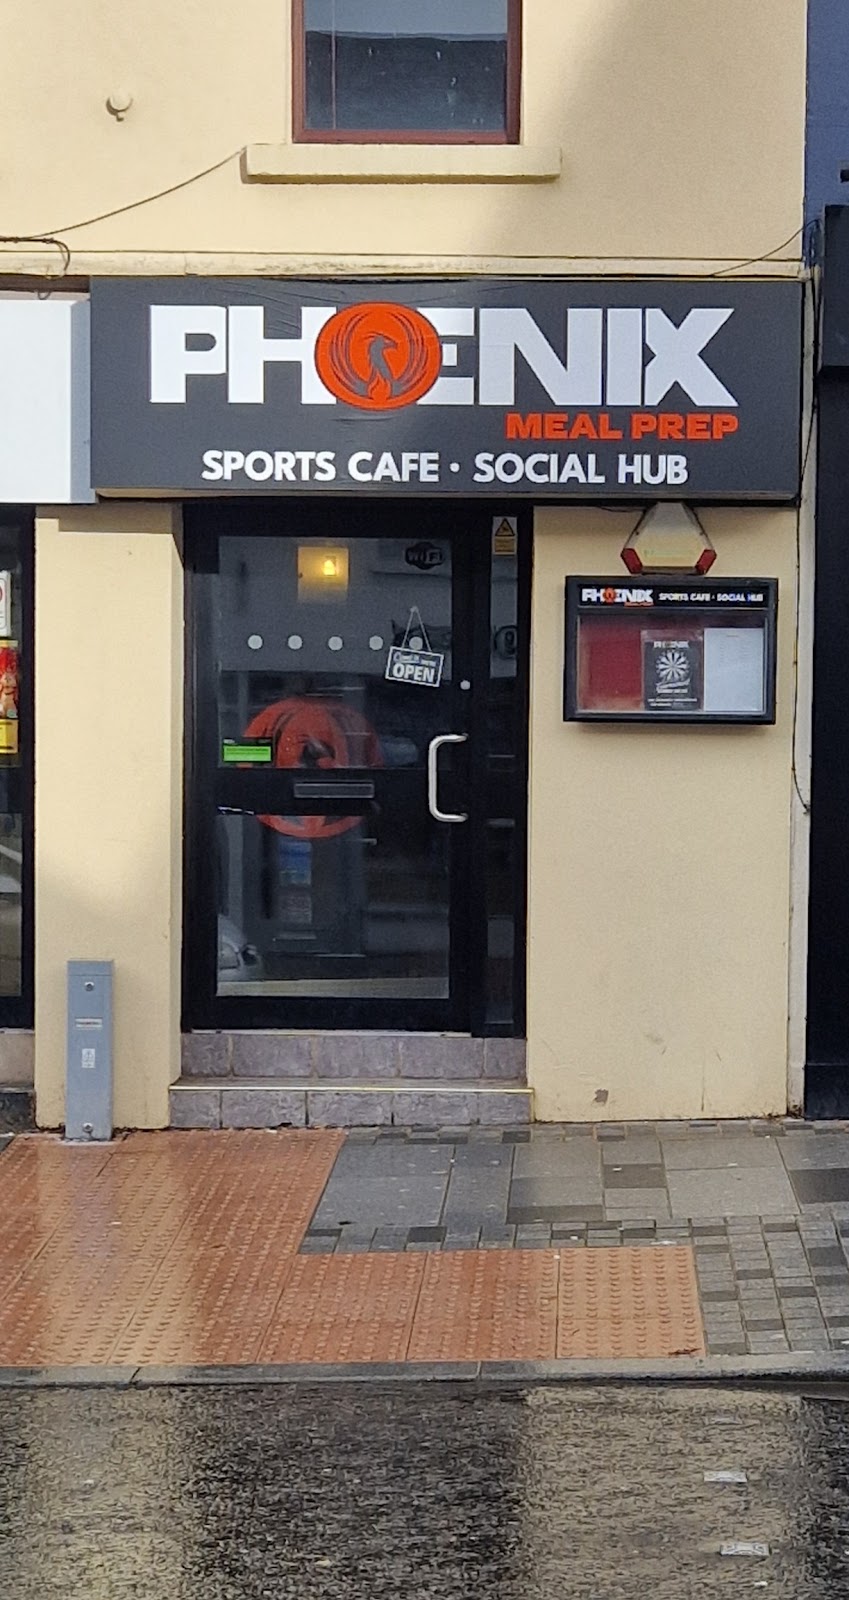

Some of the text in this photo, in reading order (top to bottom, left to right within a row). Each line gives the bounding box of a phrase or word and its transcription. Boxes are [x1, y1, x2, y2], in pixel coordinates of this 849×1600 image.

[506, 413, 739, 440] MEAL PREP
[201, 449, 688, 485] SPORTS CAFE SOCIAL HUB
[393, 663, 435, 683] OPEN
